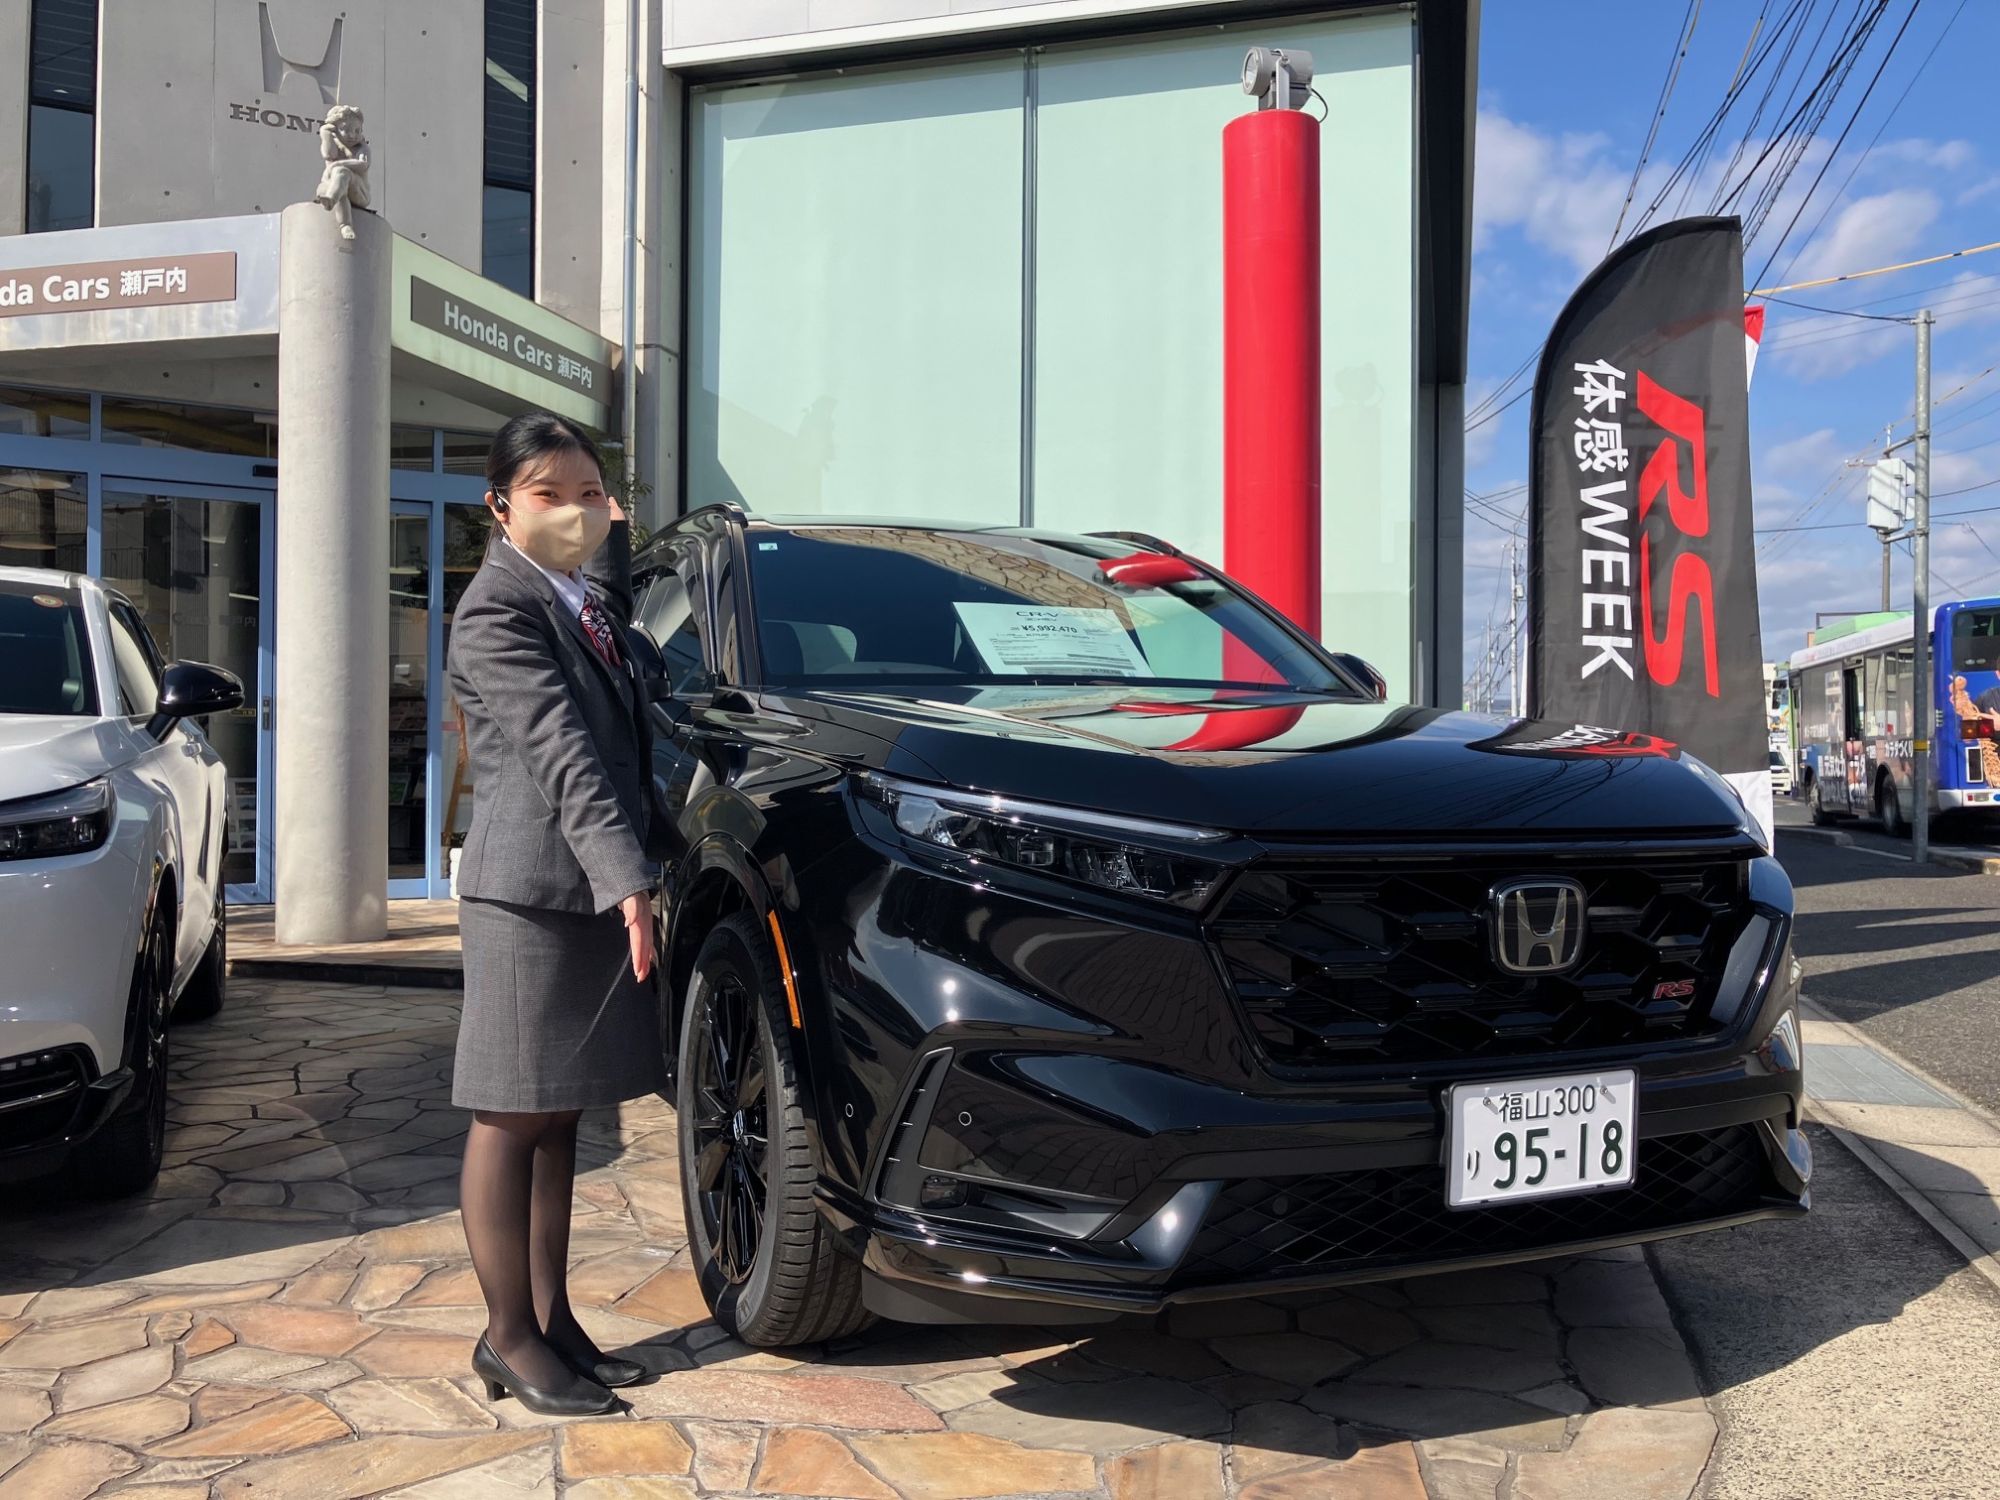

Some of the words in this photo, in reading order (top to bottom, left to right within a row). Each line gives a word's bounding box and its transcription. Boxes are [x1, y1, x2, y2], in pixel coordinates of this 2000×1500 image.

[230, 102, 345, 140] HON
[42, 275, 110, 303] Cars
[119, 266, 187, 297] 瀬戸内
[443, 300, 509, 352] Honda
[513, 334, 554, 372] Cars
[557, 353, 593, 389] 瀬戸内
[1635, 368, 1720, 699] RS
[1015, 610, 1060, 618] CR-V
[1653, 978, 1695, 1000] RS
[1492, 1118, 1624, 1190] 95-18
